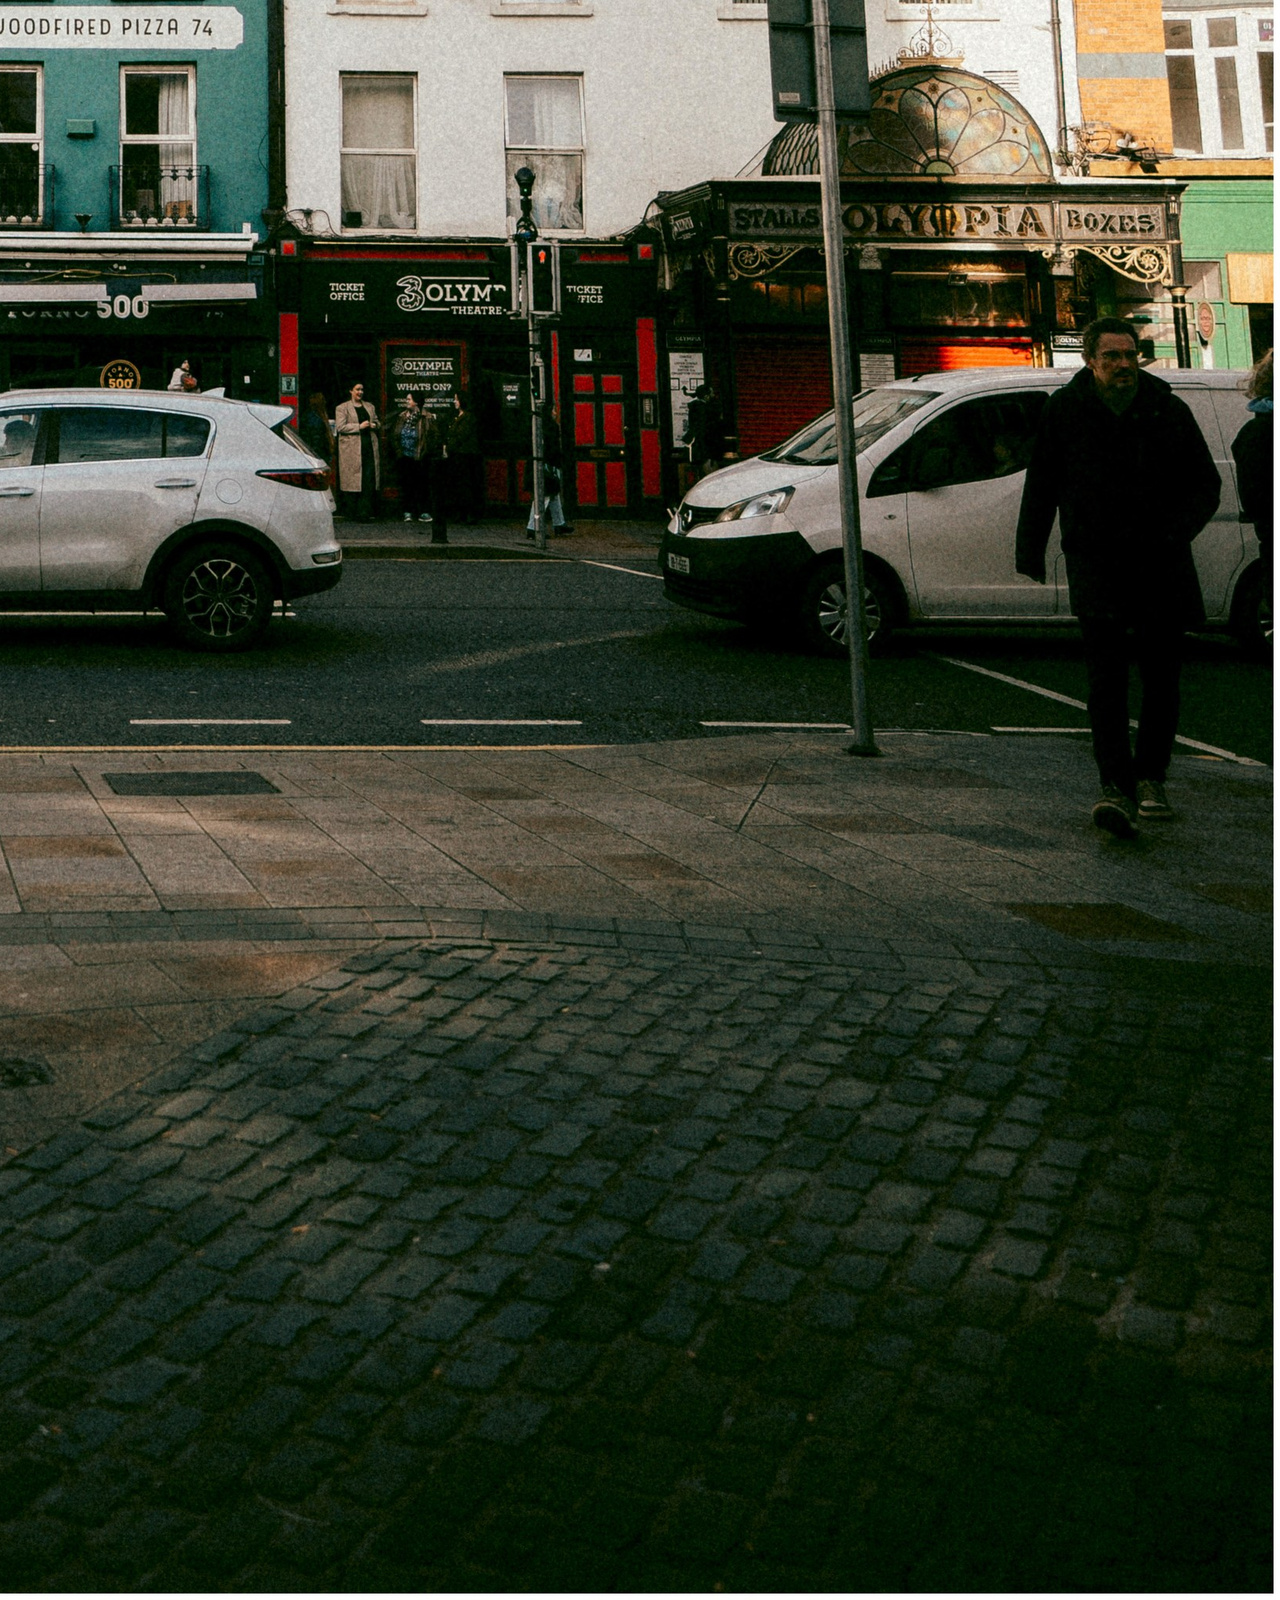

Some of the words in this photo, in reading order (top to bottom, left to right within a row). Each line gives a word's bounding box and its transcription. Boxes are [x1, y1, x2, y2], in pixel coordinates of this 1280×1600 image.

[122, 18, 179, 36] PIZZA
[192, 18, 213, 37] 74
[733, 207, 820, 231] STALLS
[841, 204, 1048, 238] OLYMPIA
[1066, 208, 1156, 234] BOXES
[329, 283, 365, 291] TICKET
[425, 284, 515, 302] OLYM
[329, 292, 365, 301] OFFICE
[577, 295, 604, 304] FICE
[96, 295, 150, 319] 500
[451, 306, 503, 315] THEATRE
[404, 361, 453, 371] OLYMPIA
[396, 383, 431, 391] WHATS
[432, 383, 452, 391] ON?
